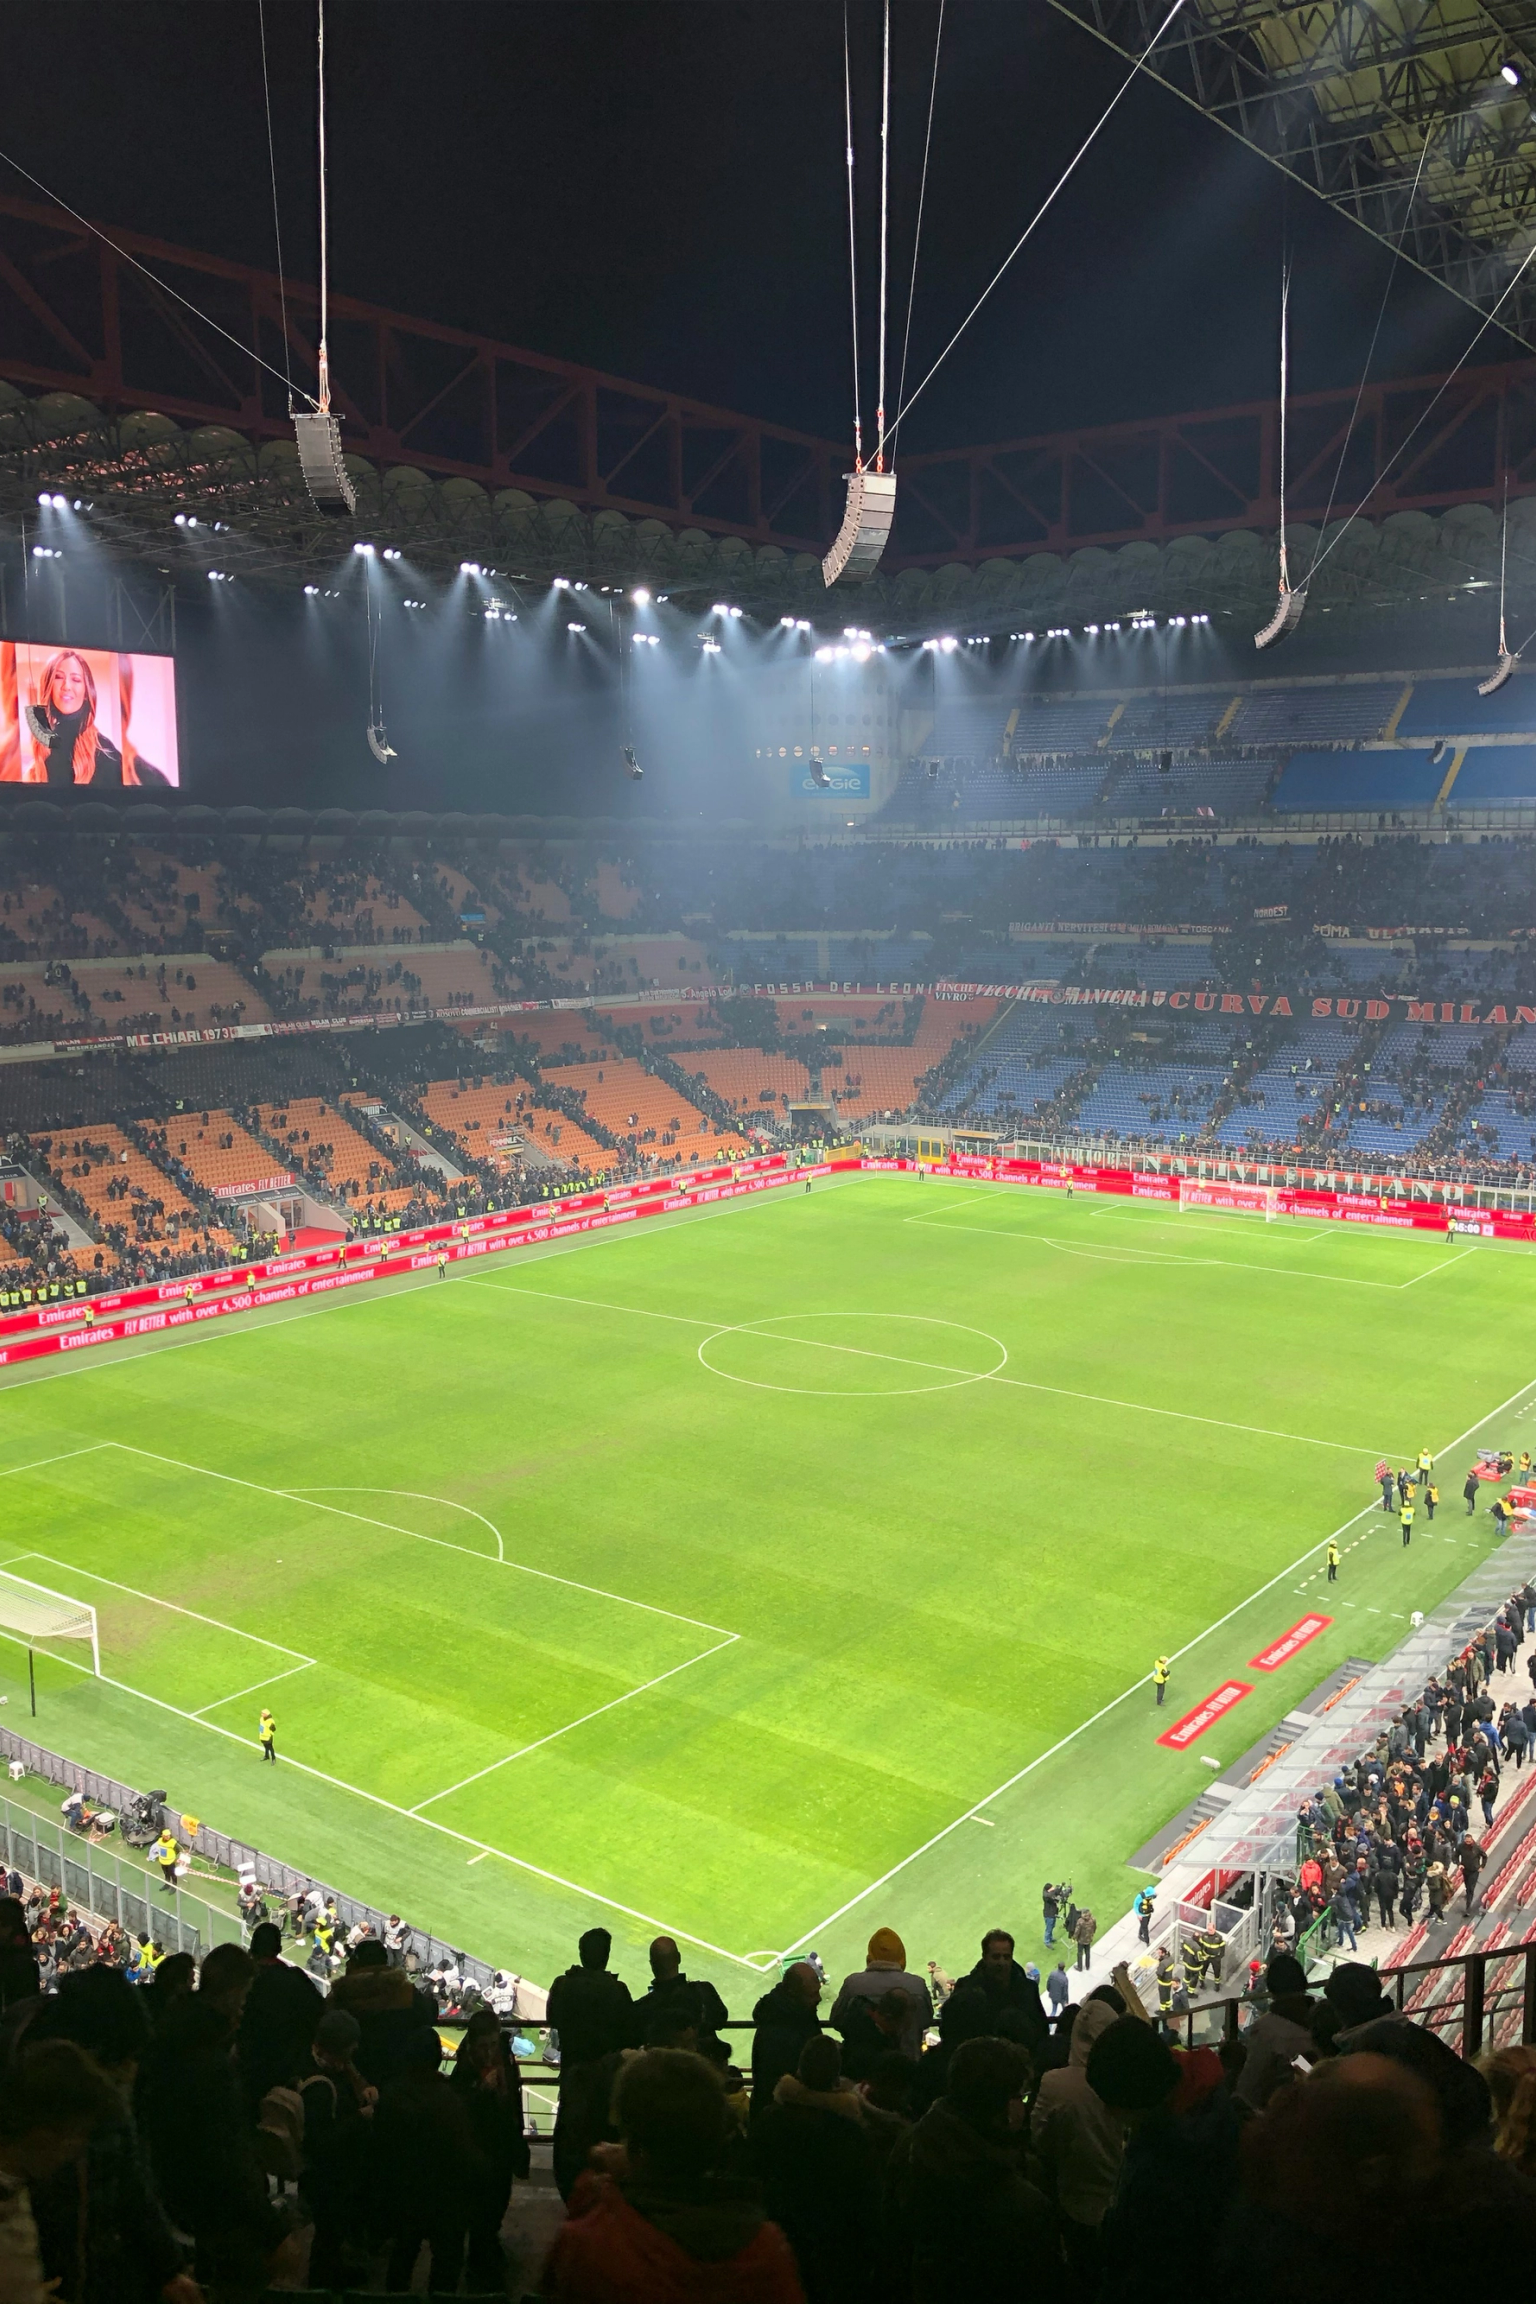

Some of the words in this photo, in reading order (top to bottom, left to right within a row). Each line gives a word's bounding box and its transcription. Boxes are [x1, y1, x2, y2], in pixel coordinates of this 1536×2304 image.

[754, 981, 814, 995] FOSSA
[829, 981, 861, 994] DEI
[876, 982, 933, 995] LEONI
[975, 984, 1049, 1004] VECCHIA
[1064, 987, 1148, 1008] MANIERA
[1169, 991, 1293, 1016] CURVA
[1311, 998, 1390, 1020] SUD
[203, 1027, 229, 1041] 1973
[213, 1182, 256, 1197] Emirates
[258, 1178, 268, 1190] FLY
[269, 1174, 291, 1189] BETTER
[935, 1166, 951, 1175] with
[953, 1169, 968, 1178] over
[971, 1169, 993, 1181] 4,500
[996, 1171, 1027, 1184] channels
[1030, 1174, 1039, 1184] of
[1133, 1173, 1169, 1185] Emirates
[1145, 1155, 1269, 1181] NATIVI
[1313, 1172, 1463, 1200] MILANO
[663, 1196, 692, 1211] Emirates
[720, 1186, 733, 1198] with
[734, 1183, 748, 1195] over
[766, 1174, 788, 1187] channels
[789, 1171, 796, 1181] of
[1336, 1194, 1378, 1208] Emirates
[1132, 1185, 1171, 1199] Emirates
[1215, 1193, 1235, 1206] with
[1237, 1197, 1257, 1209] over
[1289, 1203, 1330, 1218] channels
[1332, 1207, 1344, 1219] of
[1346, 1211, 1414, 1227] entertainment
[1447, 1206, 1491, 1220] Emirates
[489, 1236, 506, 1250] with
[508, 1234, 525, 1248] over
[527, 1229, 549, 1244] 4,500
[550, 1219, 580, 1237] channels
[581, 1217, 590, 1229] of
[591, 1207, 637, 1227] entertainment
[266, 1258, 307, 1276] Emirates
[60, 1327, 114, 1350] Emirates
[124, 1319, 139, 1335] FLY
[139, 1313, 166, 1332] BETTER
[169, 1308, 193, 1324] with
[196, 1301, 219, 1318] over
[222, 1294, 252, 1312] 4,500
[254, 1284, 296, 1305] channels
[298, 1280, 309, 1295] of
[311, 1268, 375, 1294] entertainment
[1260, 1638, 1301, 1666] Emirates
[1170, 1710, 1215, 1742] Emirates
[1206, 1698, 1224, 1713] FLY
[1216, 1686, 1242, 1708] BETTER
